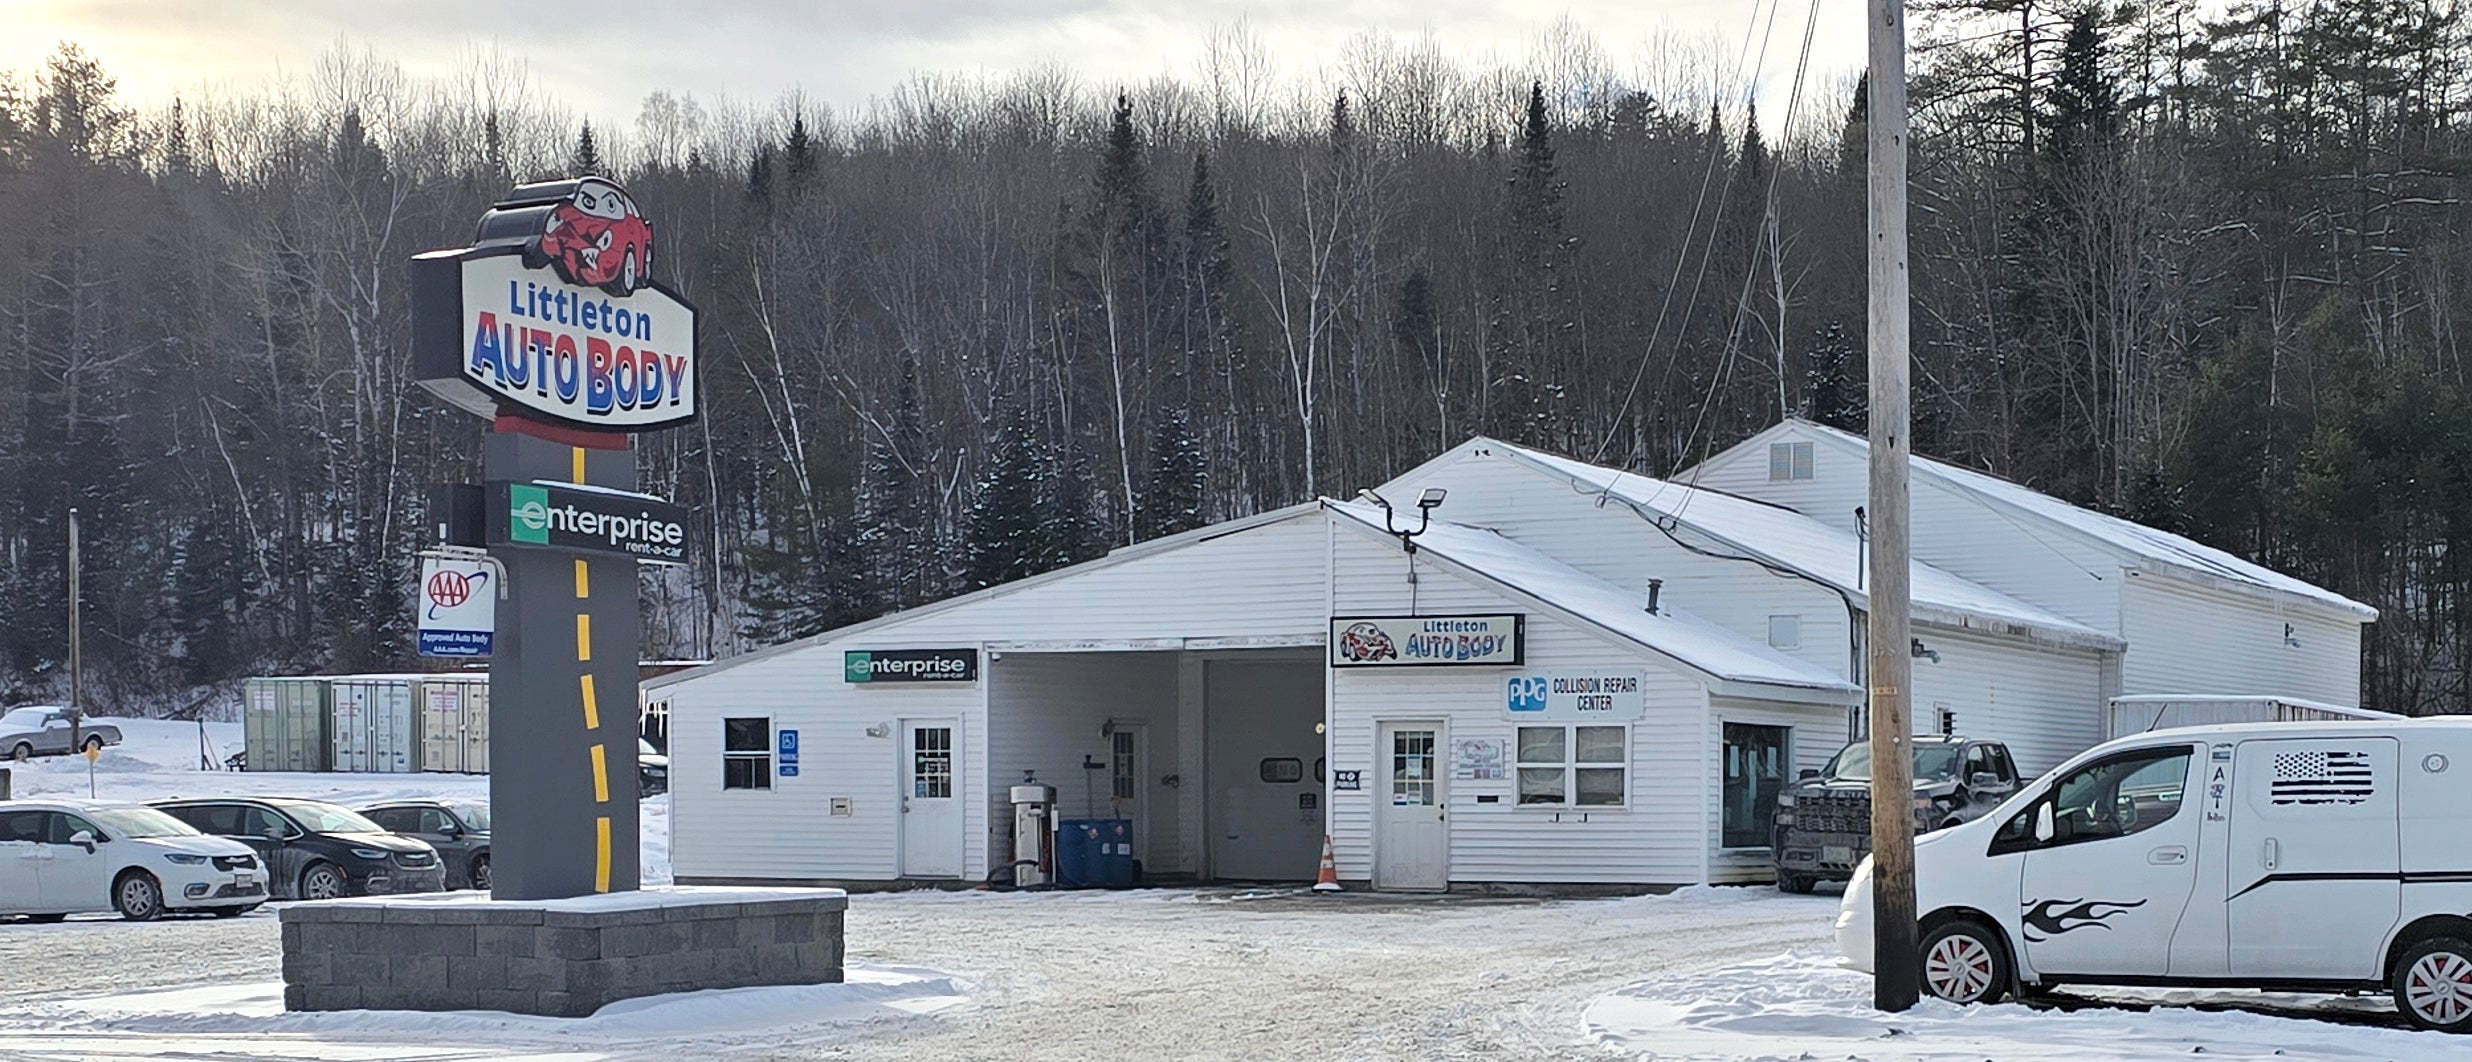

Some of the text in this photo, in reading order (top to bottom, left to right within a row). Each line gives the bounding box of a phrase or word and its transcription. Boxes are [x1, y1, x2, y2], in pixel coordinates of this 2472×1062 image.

[510, 281, 651, 341] Littleton
[471, 311, 688, 416] AUTO BODY
[519, 501, 683, 545] enterprise
[625, 541, 682, 557] rent-a-car
[430, 571, 467, 607] AAA
[1424, 621, 1488, 633] Littleton
[1405, 633, 1508, 661] AUTO BODY
[853, 655, 965, 677] enterprise
[1509, 677, 1546, 706] PPG
[1553, 677, 1637, 693] COLLISION REPAIR
[1577, 695, 1612, 711] CENTER
